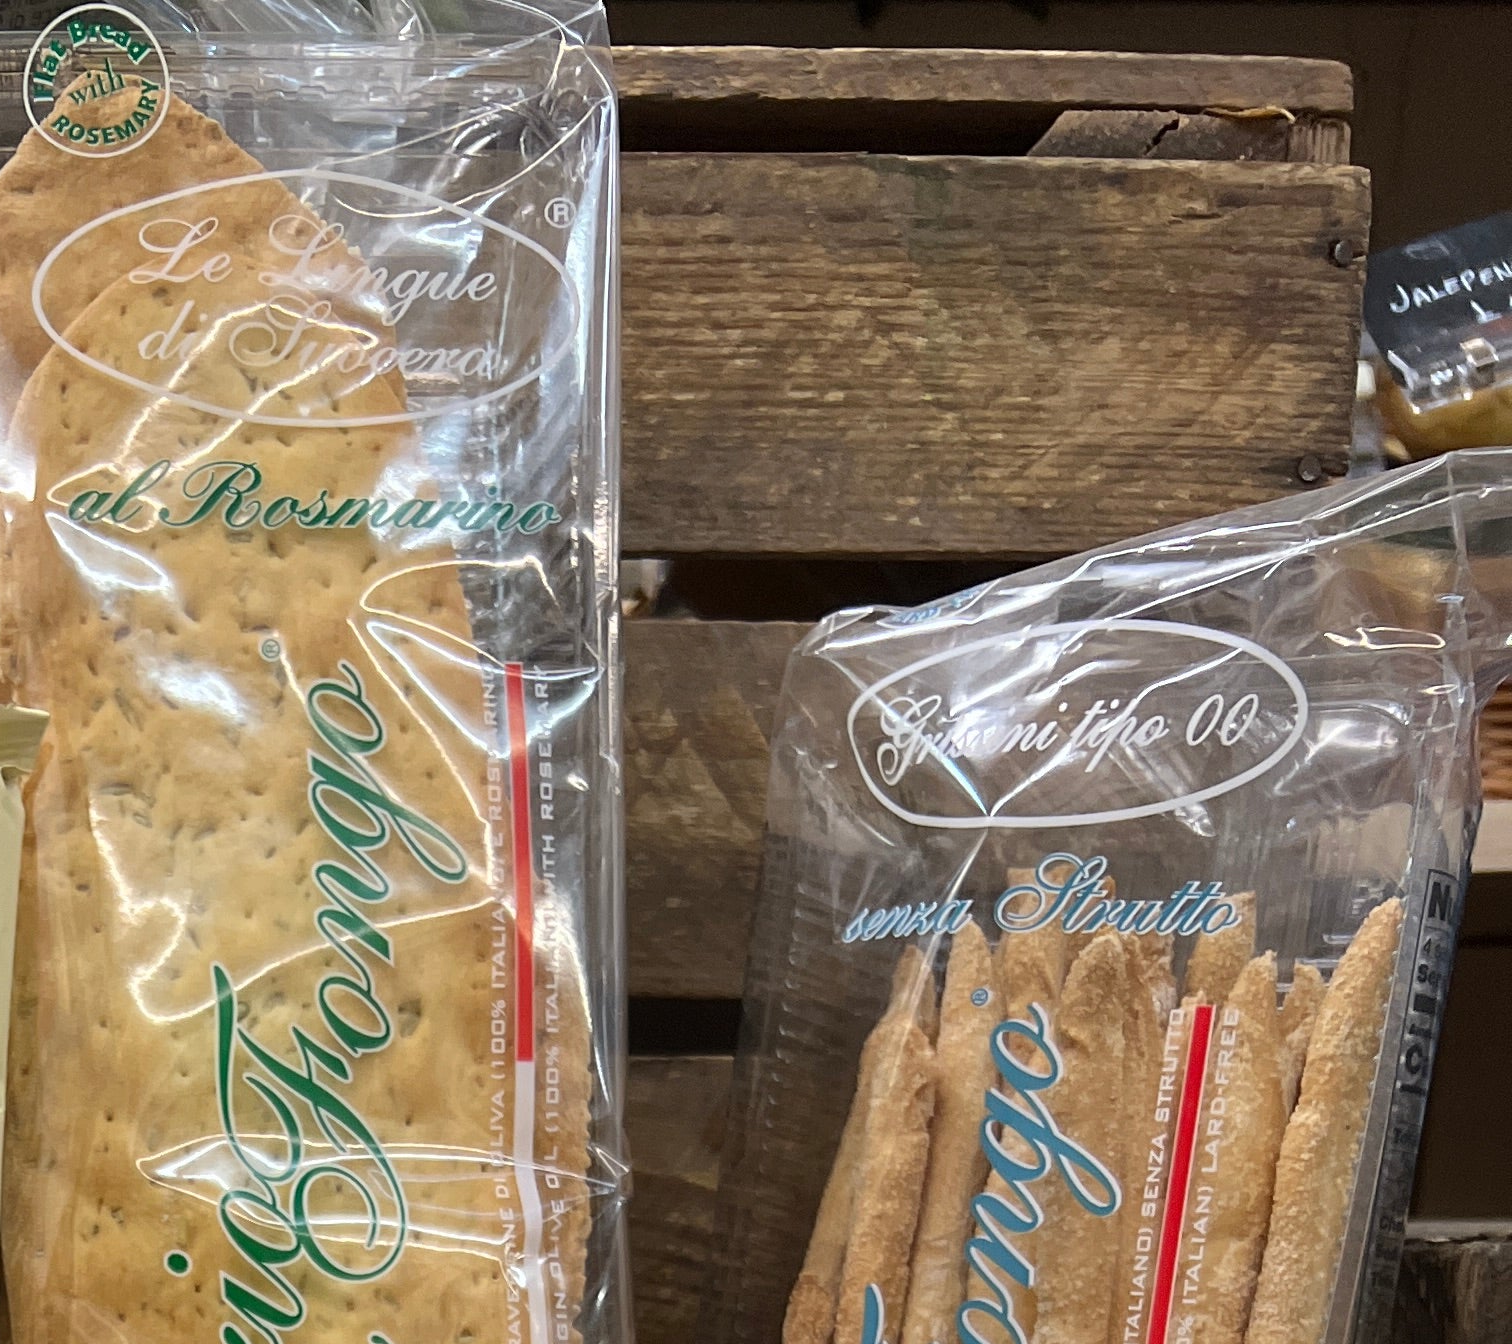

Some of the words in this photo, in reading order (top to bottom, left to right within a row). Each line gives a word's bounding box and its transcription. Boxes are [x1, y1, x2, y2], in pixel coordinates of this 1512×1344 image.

[33, 40, 69, 102] Flat
[67, 19, 152, 65] Bread
[68, 57, 126, 106] with
[51, 80, 160, 145] ROSEMARY
[128, 216, 233, 284] Le
[137, 300, 210, 364] di
[228, 295, 505, 381] Suocera
[65, 459, 163, 526] al
[160, 461, 561, 534] Rosmarino
[876, 694, 1064, 786] Grisni
[1064, 697, 1170, 774] tipo
[1184, 692, 1261, 747] 00
[539, 834, 558, 895] WITH
[841, 893, 973, 945] senza
[994, 853, 1240, 938] Strutto
[491, 999, 508, 1080] (100%
[490, 1090, 508, 1167] OLIVA
[544, 1045, 561, 1133] (100%
[1141, 1132, 1167, 1218] SENZA
[1154, 1007, 1185, 1123] STRUTTO
[494, 1176, 510, 1199] DI
[1181, 1185, 1212, 1305] ITALIAN)
[1199, 1007, 1240, 1173] LARD-FREE
[548, 1199, 566, 1277] OLIVE
